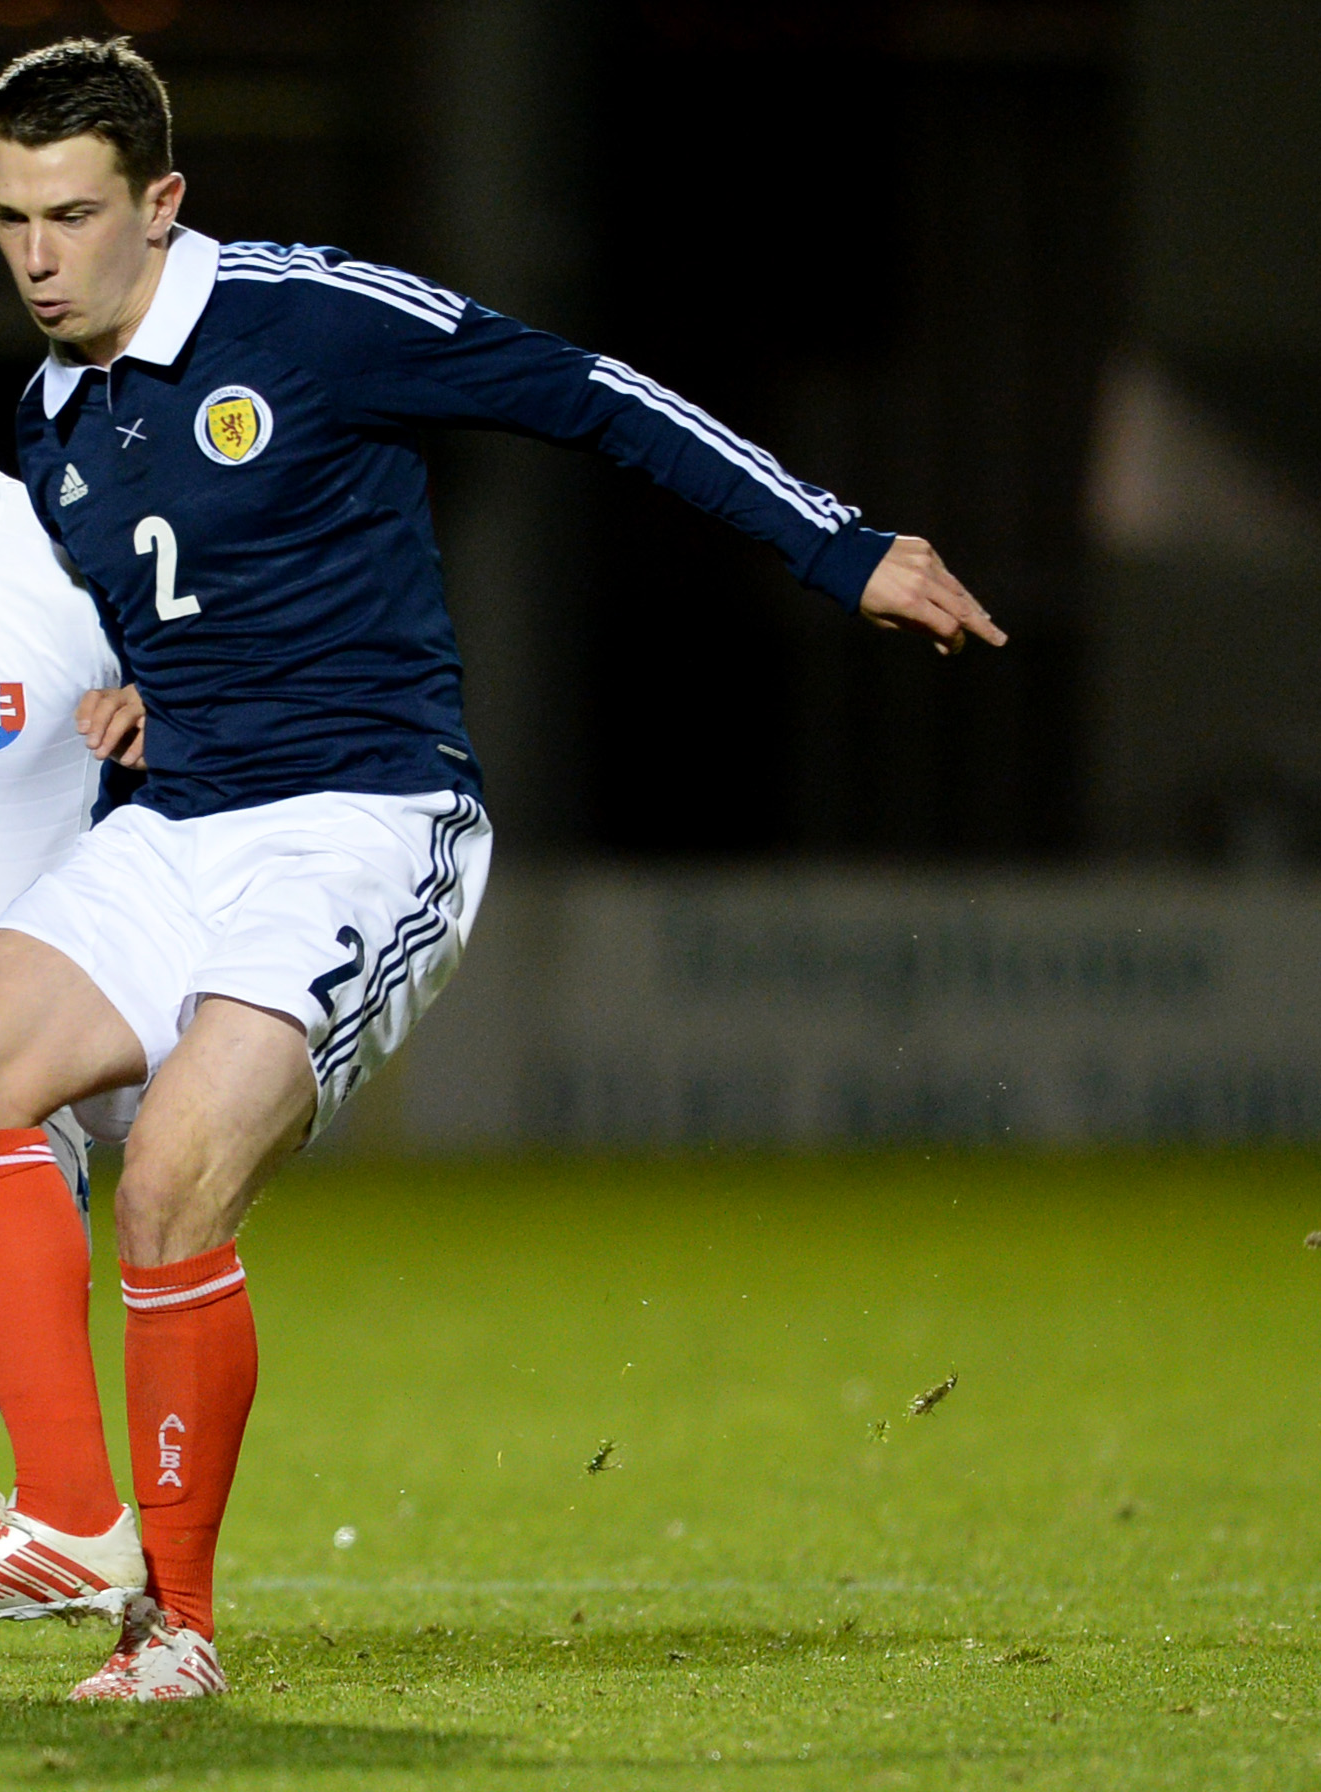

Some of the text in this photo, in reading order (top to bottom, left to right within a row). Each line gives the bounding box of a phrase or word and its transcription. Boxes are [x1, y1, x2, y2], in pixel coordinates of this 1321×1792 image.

[133, 515, 202, 621] 2
[307, 925, 365, 1019] 2
[157, 1413, 186, 1488] ALBA
